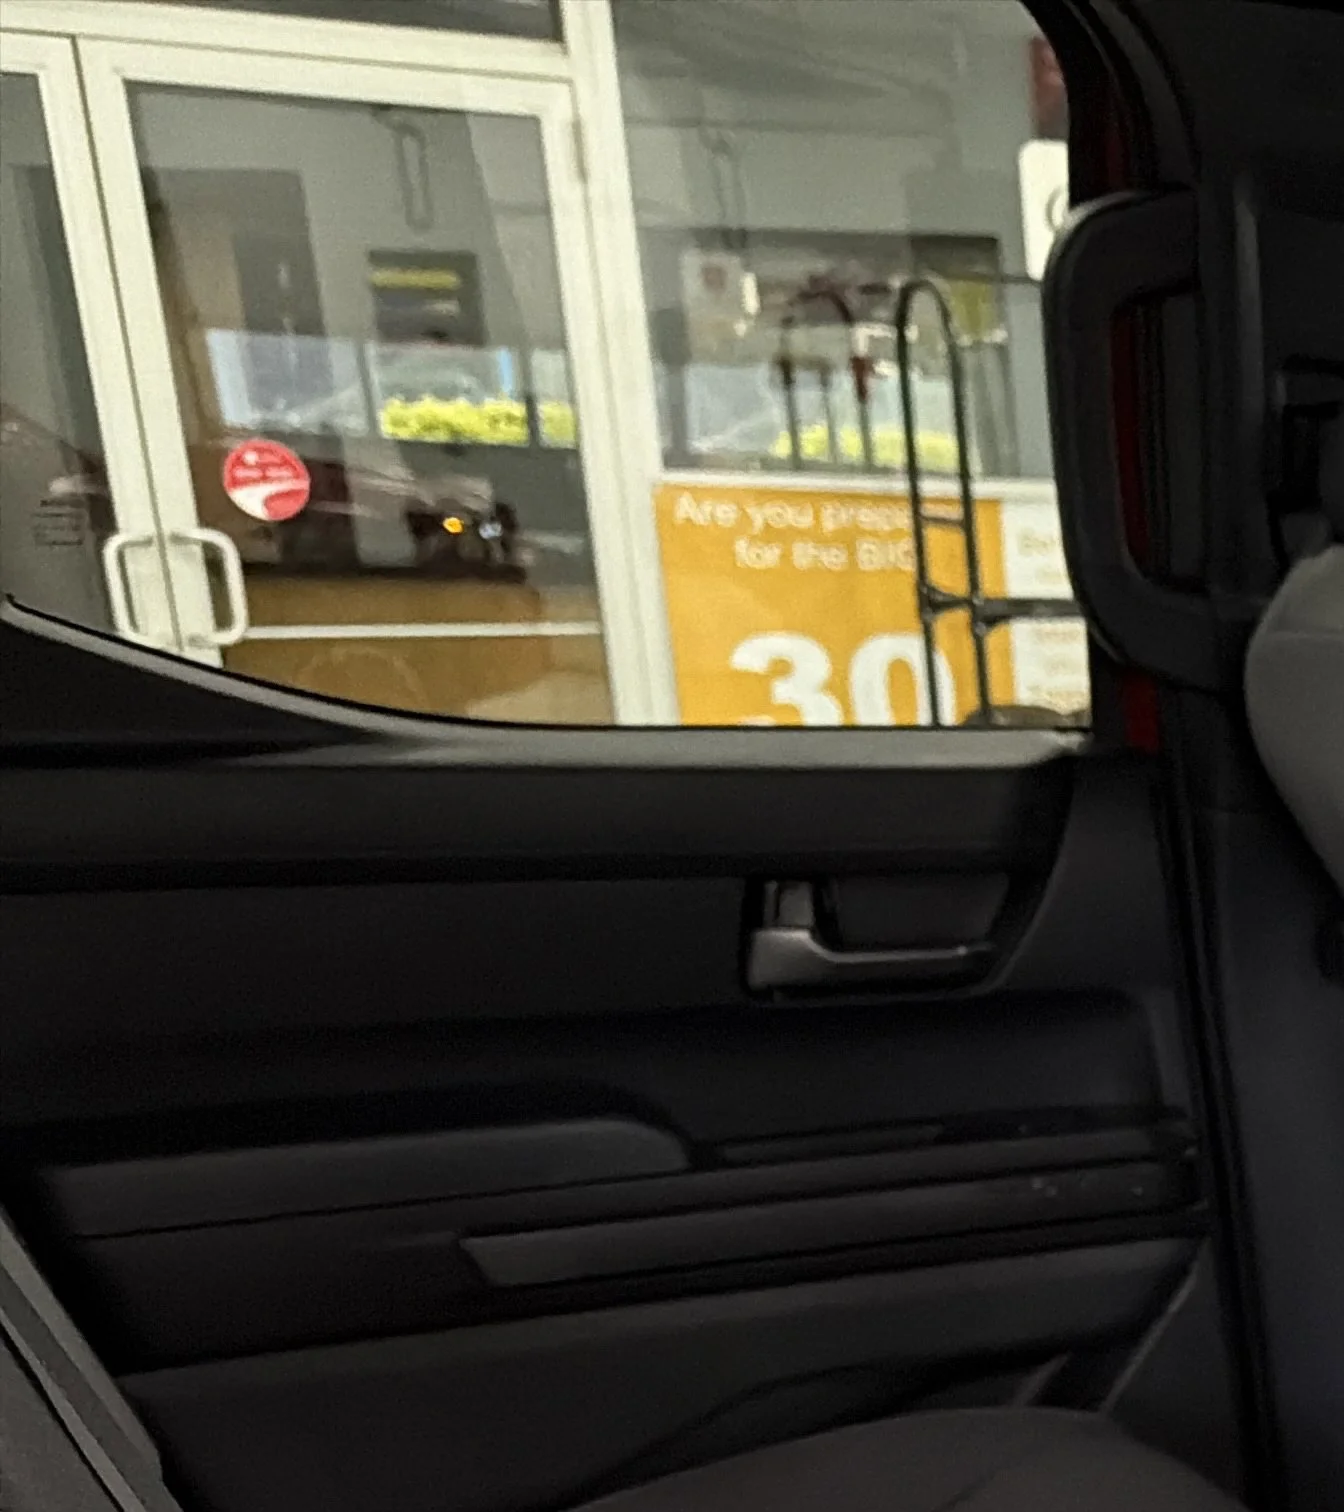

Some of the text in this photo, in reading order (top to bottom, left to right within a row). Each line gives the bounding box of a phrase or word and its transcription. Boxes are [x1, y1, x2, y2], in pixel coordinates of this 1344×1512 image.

[673, 491, 739, 527] Are
[743, 499, 814, 535] you
[734, 535, 782, 569] for
[792, 538, 848, 571] the
[729, 631, 957, 726] 30
